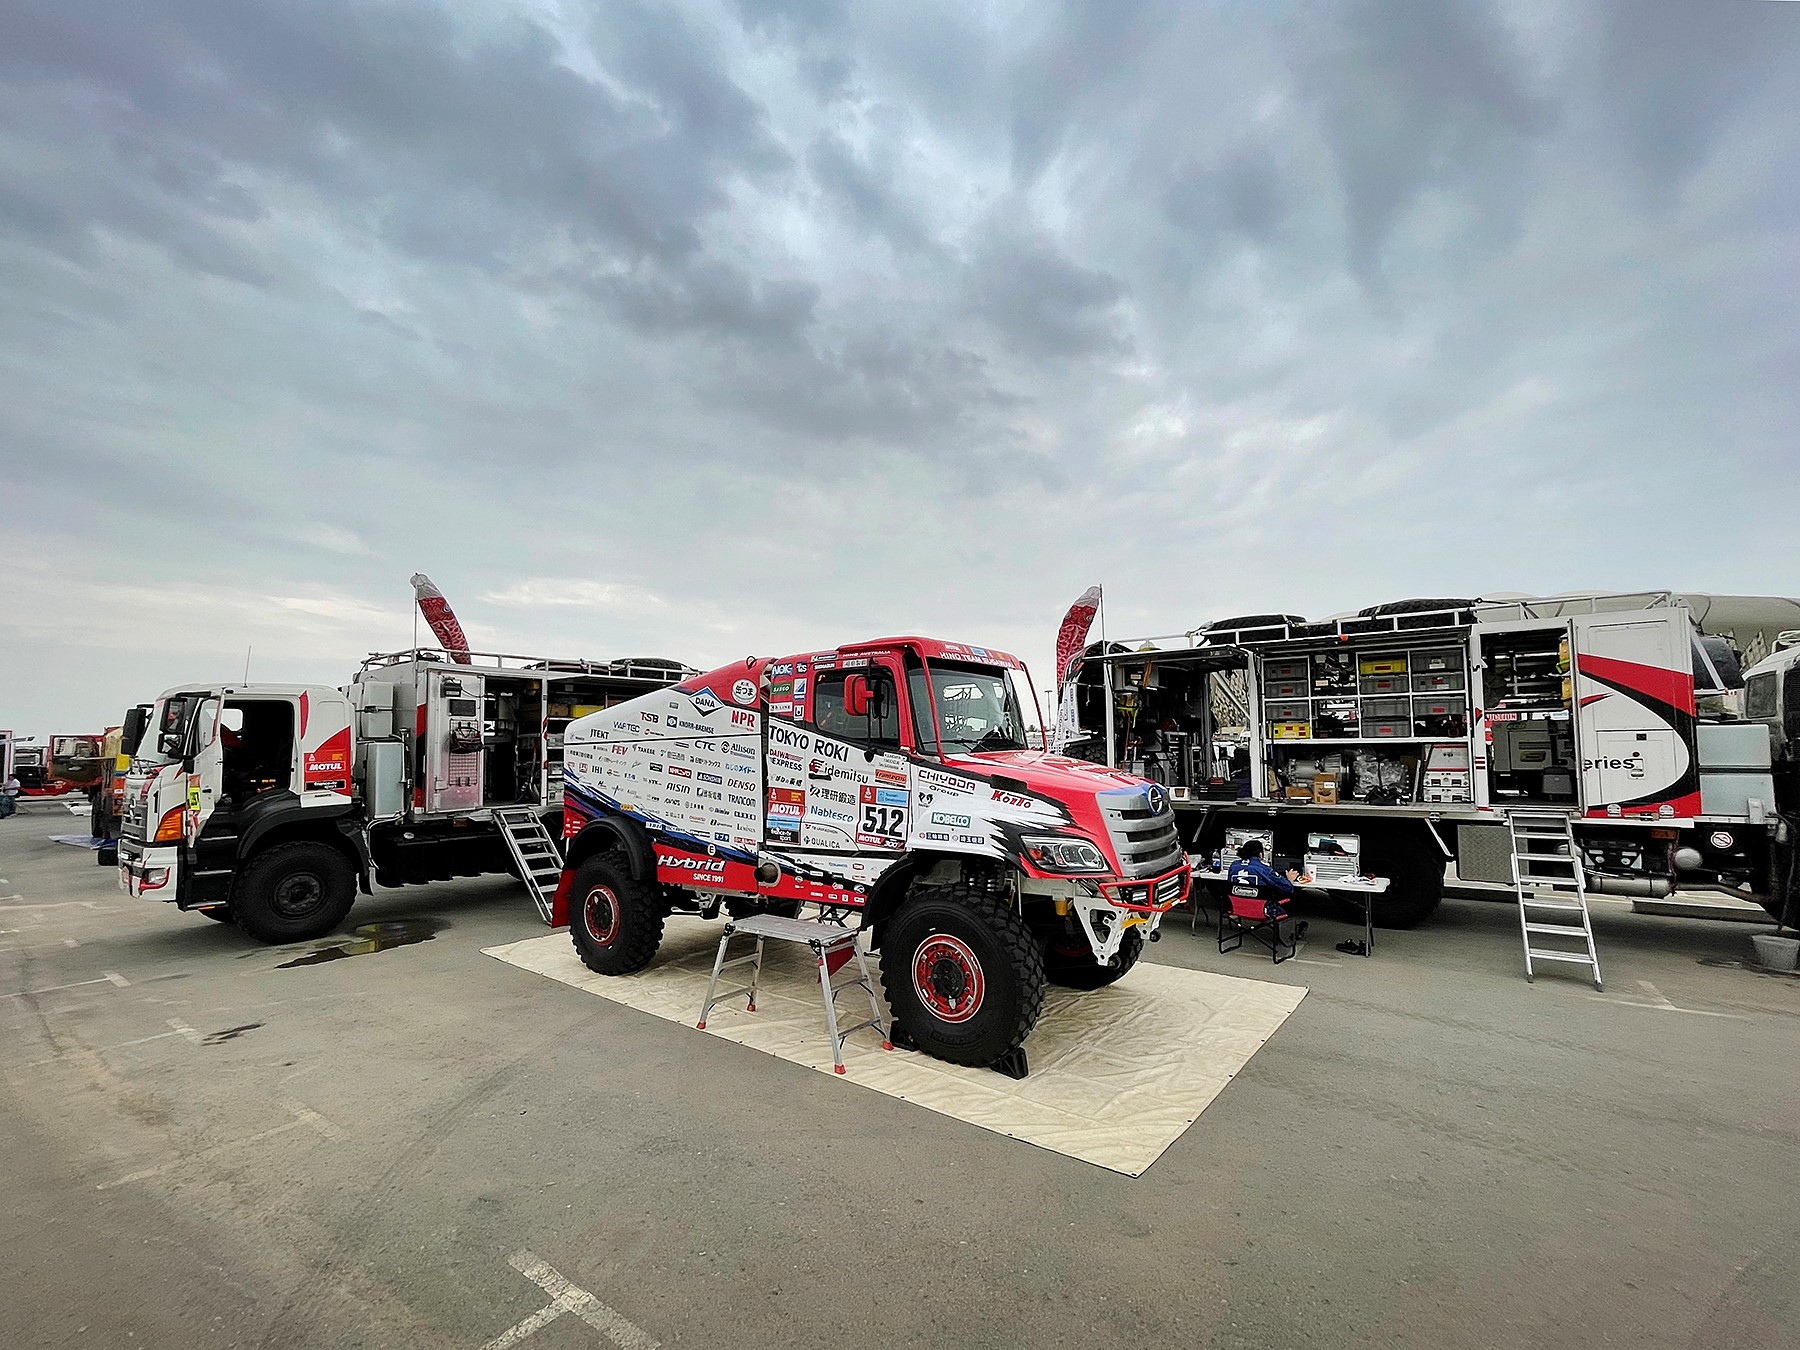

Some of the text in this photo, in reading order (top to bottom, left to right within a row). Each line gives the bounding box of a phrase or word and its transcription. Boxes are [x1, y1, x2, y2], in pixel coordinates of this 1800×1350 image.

[940, 652, 961, 661] HINO
[695, 697, 715, 708] DANA
[640, 711, 659, 723] TSB
[731, 710, 756, 727] NPR
[679, 720, 715, 734] KNORR-BREMSE
[590, 728, 609, 740] JTEKT
[611, 744, 628, 756] FEV
[694, 740, 717, 751] CTC
[731, 742, 756, 756] Allison
[769, 725, 809, 750] TOKYO
[813, 738, 850, 762] ROKI
[309, 763, 343, 771] MOTUL
[592, 765, 603, 775] IHI
[772, 757, 803, 772] EXPRESS
[824, 763, 868, 784] idemitsu
[727, 778, 756, 792] DENSO
[918, 769, 976, 792] CHIYODA
[666, 782, 691, 795] AISIN
[929, 785, 959, 797] Group
[821, 787, 857, 806] 理研鍛造
[771, 803, 801, 815] MOTUL
[811, 805, 854, 823] Nabtesco
[863, 806, 904, 837] 512
[933, 812, 970, 827] KOBELCO
[811, 837, 840, 849] QUALICA
[859, 835, 881, 844] MOTUL
[657, 855, 727, 872] Hybrid
[693, 873, 724, 883] SINCE 1991
